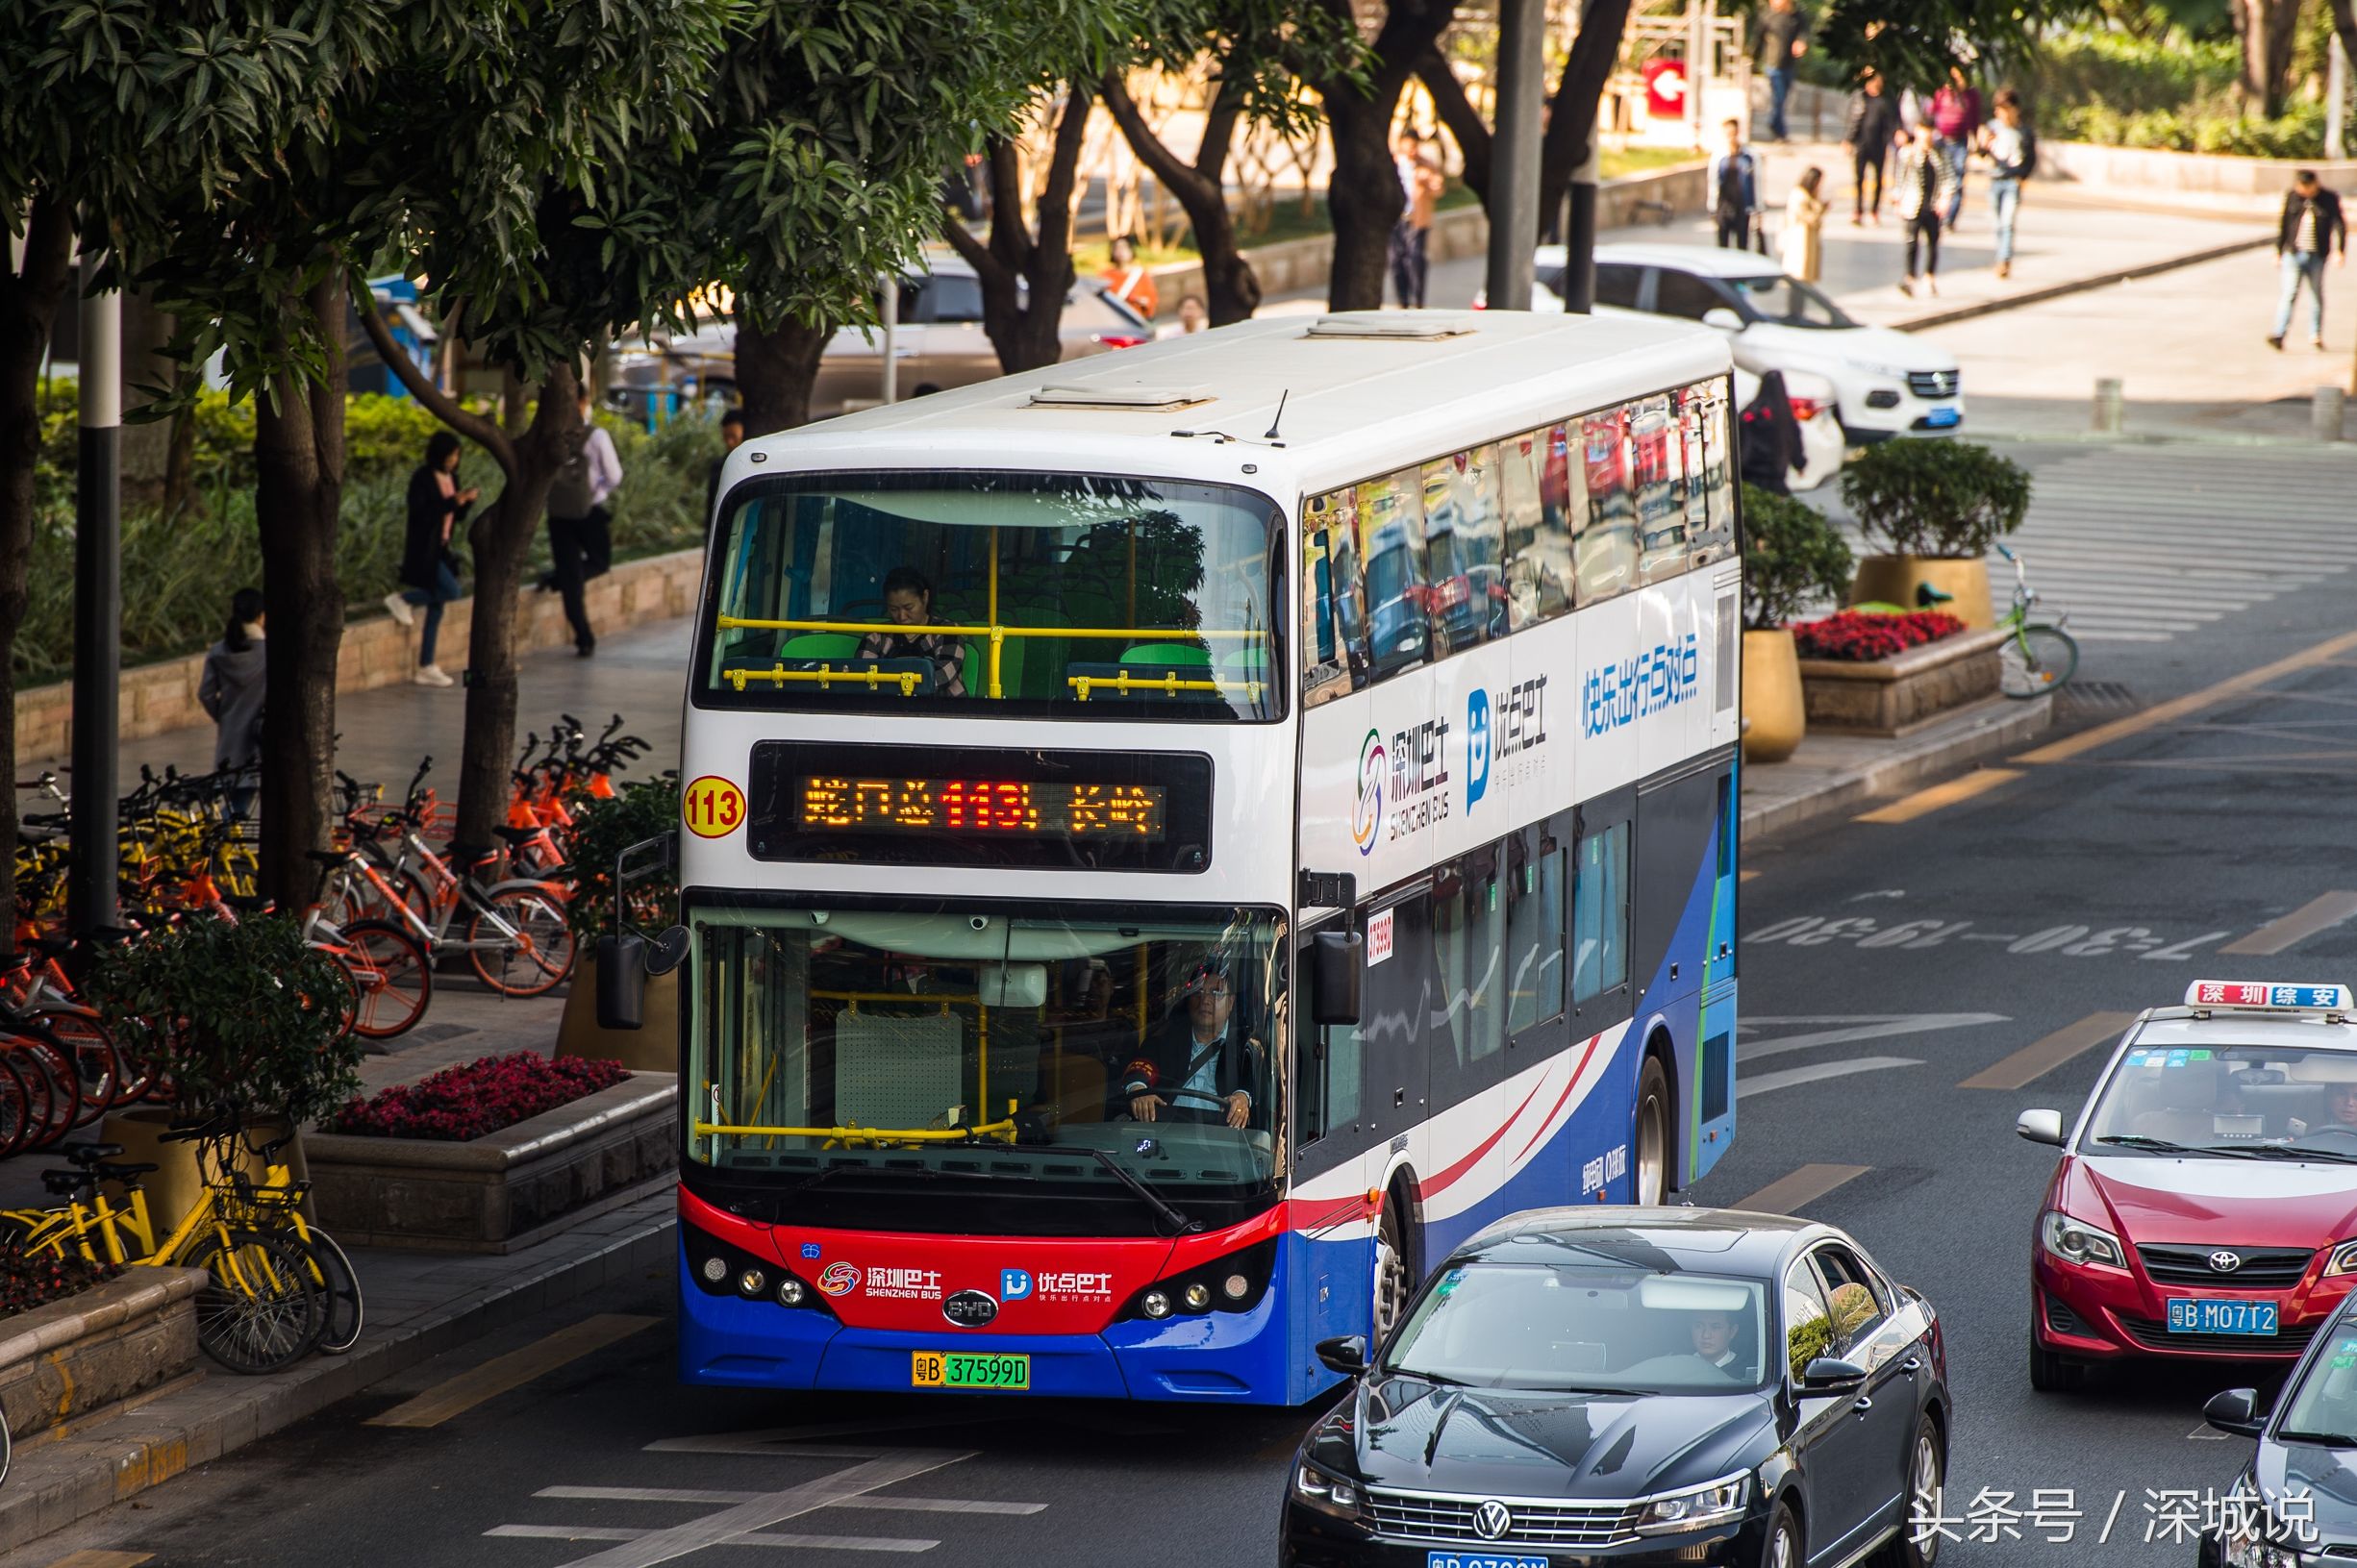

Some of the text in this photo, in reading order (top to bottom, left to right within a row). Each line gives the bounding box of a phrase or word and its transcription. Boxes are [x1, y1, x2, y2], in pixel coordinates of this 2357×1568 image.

[1582, 633, 1696, 740] 快乐出行点对点
[1494, 673, 1547, 762] 优点巴士
[1391, 715, 1449, 803] 深圳巴士
[688, 789, 739, 826] 113
[1391, 791, 1449, 841] SHENZHEN BUS
[865, 1266, 942, 1290] 深圳巴士
[1038, 1272, 1113, 1294] 优点巴士
[865, 1287, 942, 1301] SHENZHEN BUS
[948, 1301, 991, 1317] BYD
[1039, 1294, 1112, 1303] 快乐出行点对点
